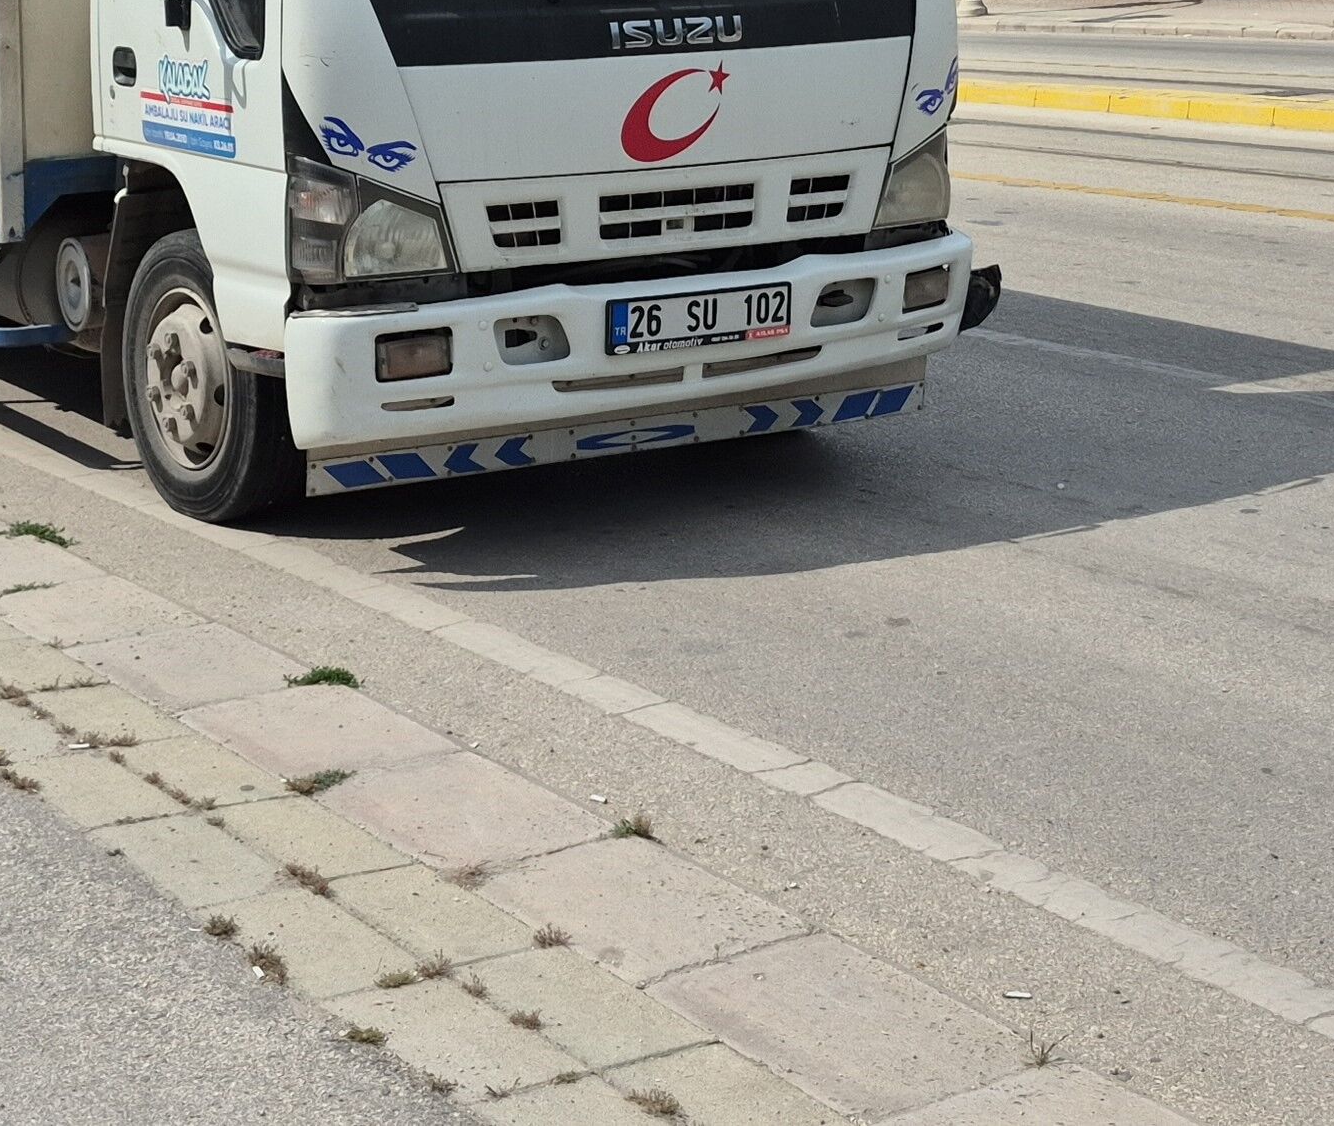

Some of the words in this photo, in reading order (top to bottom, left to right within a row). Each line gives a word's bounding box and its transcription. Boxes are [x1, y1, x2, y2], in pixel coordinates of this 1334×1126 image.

[609, 14, 744, 50] ISUZU
[179, 110, 189, 123] SU
[188, 109, 209, 127] NAKİL
[629, 303, 662, 339] 26
[687, 297, 718, 333] SU
[743, 290, 786, 326] 102
[614, 325, 627, 337] TR
[663, 337, 704, 350] otomotiv
